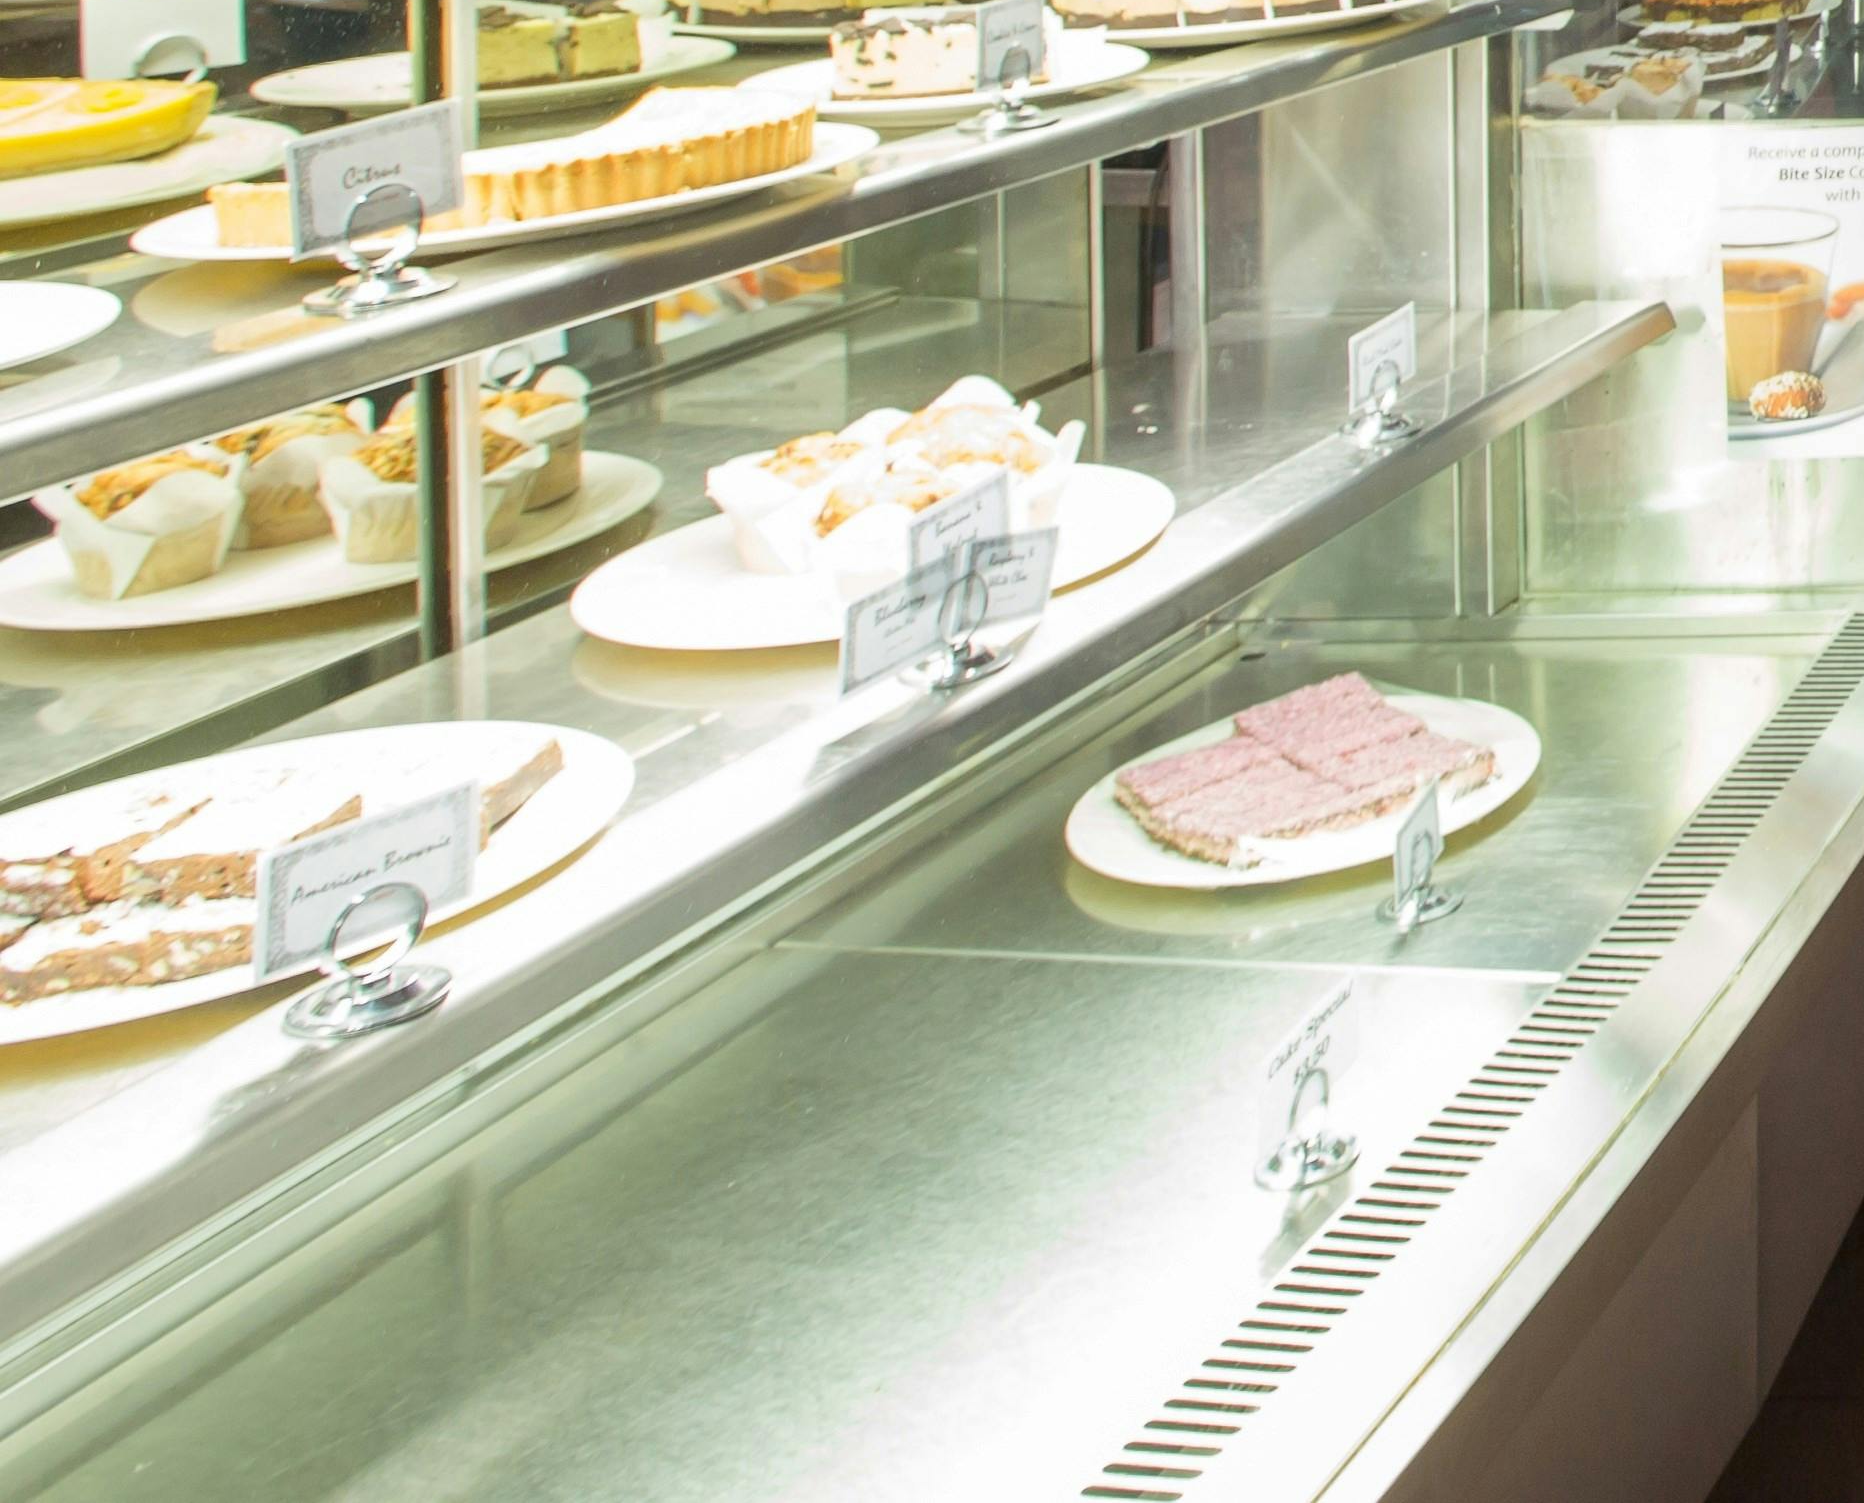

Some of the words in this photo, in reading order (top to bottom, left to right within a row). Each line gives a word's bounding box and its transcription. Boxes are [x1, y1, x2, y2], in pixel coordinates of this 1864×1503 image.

[1748, 145, 1806, 161] Receive
[1810, 148, 1819, 159] a
[343, 164, 401, 189] Citrus
[1778, 167, 1810, 181] Bite
[1814, 165, 1845, 180] Size
[1825, 187, 1861, 202] with
[291, 867, 376, 907] American
[384, 835, 451, 872] Brownie
[1305, 978, 1354, 1041] Special
